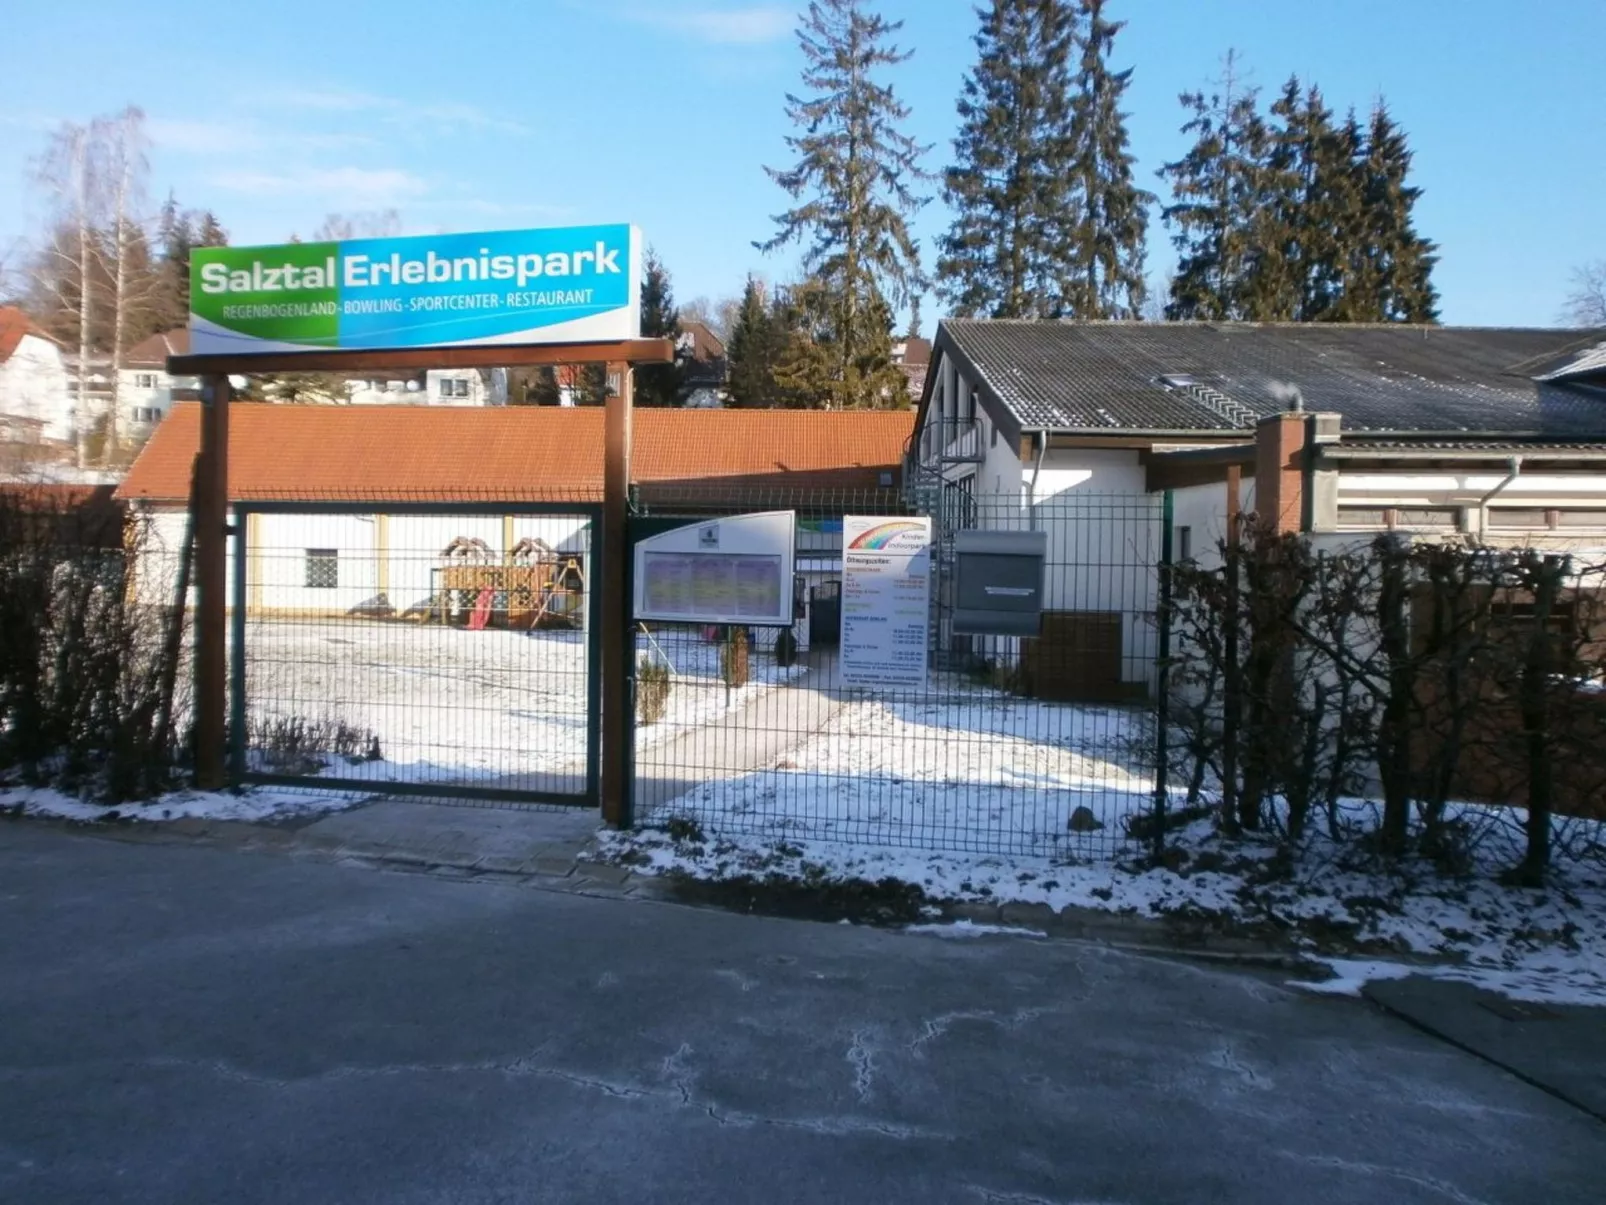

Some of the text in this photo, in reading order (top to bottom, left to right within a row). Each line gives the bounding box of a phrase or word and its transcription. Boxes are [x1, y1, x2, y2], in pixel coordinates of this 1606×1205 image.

[201, 241, 621, 293] Salztal Erlebnispark
[223, 301, 336, 319] REGENBOGENLAND
[344, 298, 402, 314] BOWLING
[410, 293, 499, 312] SPORTCENTER
[506, 289, 593, 307] RESTAURANT
